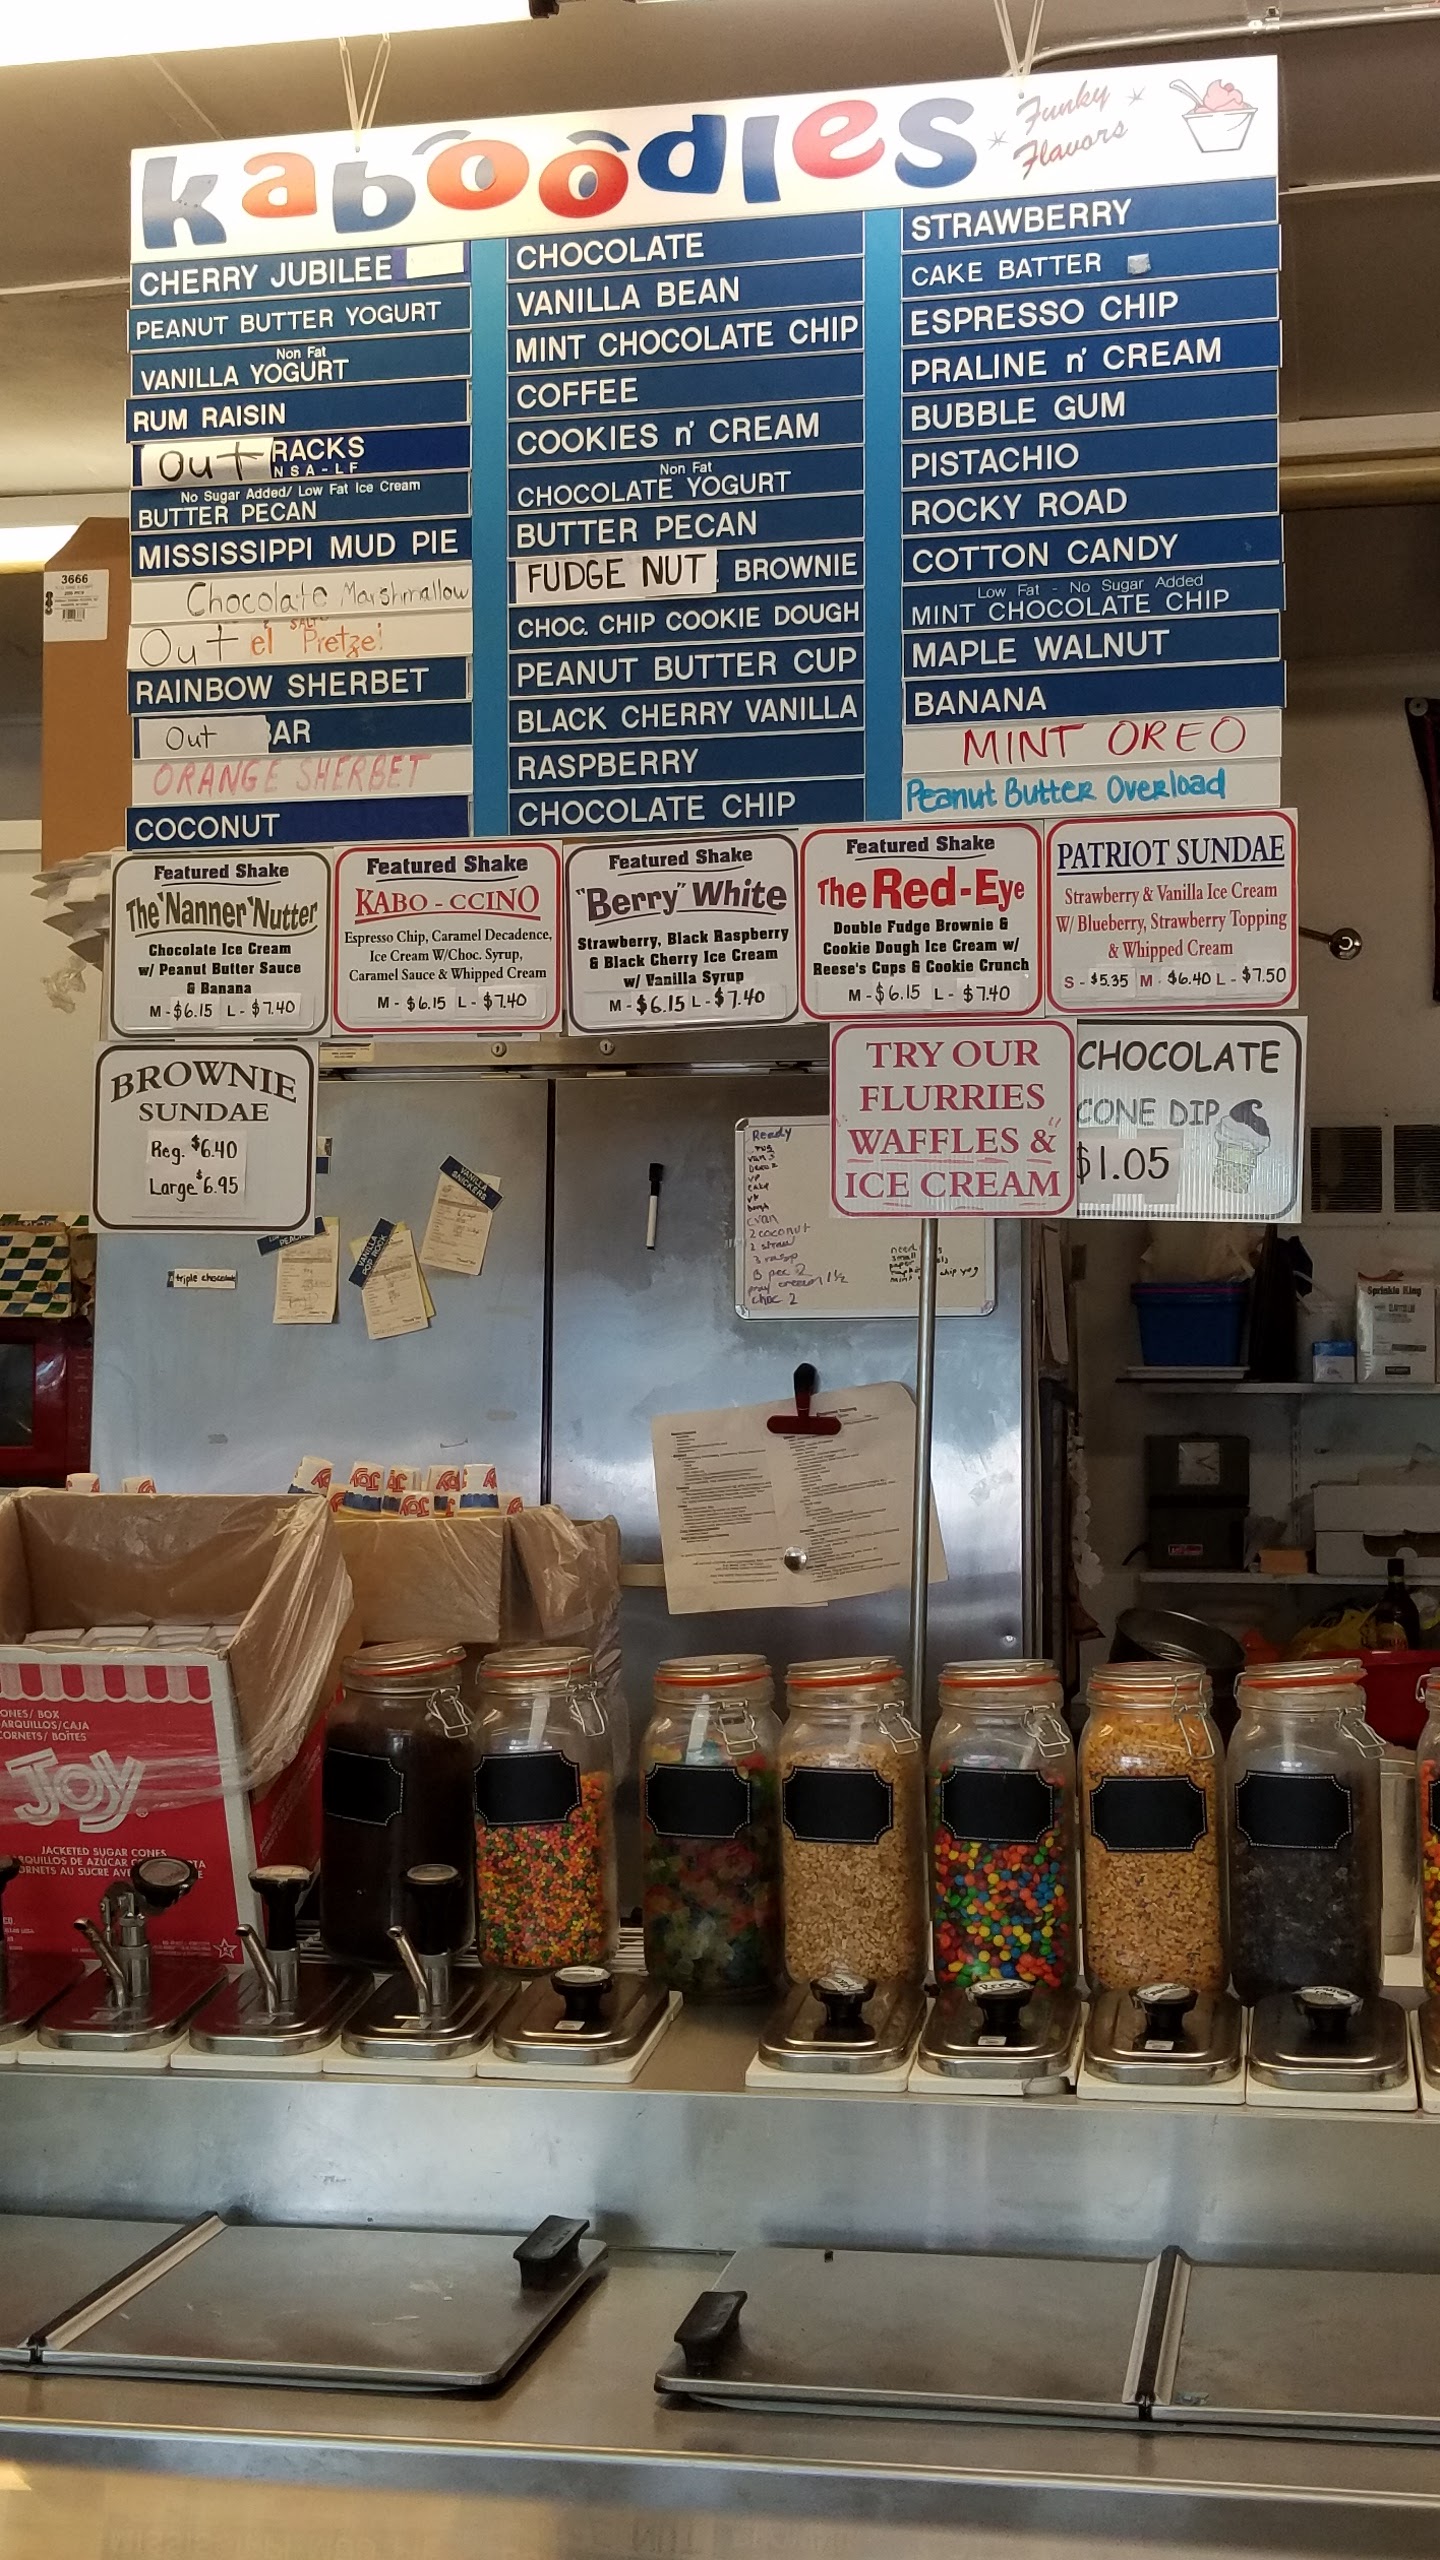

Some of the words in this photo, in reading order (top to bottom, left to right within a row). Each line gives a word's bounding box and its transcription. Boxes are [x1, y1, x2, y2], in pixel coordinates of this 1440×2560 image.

[1016, 80, 1111, 136] Funky
[1013, 120, 1128, 180] Flavors
[142, 97, 977, 249] kaboodles
[911, 198, 1132, 241] STRAWBERRY
[516, 232, 704, 270] CHOCOLATE
[139, 264, 258, 297] CHERRY
[270, 255, 392, 288] JUBILEE
[912, 261, 983, 286] CAKE
[999, 252, 1101, 280] BATTER
[516, 284, 641, 316] VANILLA
[657, 276, 739, 308] BEAN
[136, 316, 229, 340] PEANUT
[240, 310, 334, 334] BUTTER
[346, 301, 441, 326] YOGURT
[911, 299, 1085, 336] ESPRESSO
[1100, 291, 1179, 321] CHIP
[276, 348, 301, 360] Non
[308, 345, 326, 358] Fat
[141, 366, 239, 391] VANILLA
[250, 359, 349, 384] YOGURT
[517, 377, 638, 409] COFFEE
[133, 409, 188, 432] RUM
[202, 403, 286, 428] RAISIN
[911, 397, 1036, 431] BUBBLE
[1054, 391, 1125, 421] GUM
[272, 435, 365, 462] RACKS
[517, 423, 659, 455] COOKIES
[709, 413, 819, 443] CREAM
[159, 442, 264, 481] Out
[911, 443, 1079, 479] PISTACHIO
[181, 492, 198, 503] No
[204, 490, 240, 504] Sugar
[299, 485, 323, 497] Low
[329, 483, 348, 495] Fat
[355, 481, 374, 493] Ice
[380, 480, 421, 492] Cream
[911, 493, 1022, 526] ROCKY
[1038, 488, 1128, 518] ROAD
[138, 537, 313, 570] MISSISSIPPI
[331, 533, 396, 560] MUD
[412, 529, 459, 555] PIE
[912, 542, 1048, 574] COTTON
[1067, 533, 1179, 565] CANDY
[61, 574, 89, 584] 3666
[528, 557, 626, 593] FUDGE
[642, 553, 707, 587] NUT
[735, 552, 857, 582] BROWNIE
[187, 582, 328, 616] Chocolate
[977, 586, 1006, 599] Low
[1017, 584, 1040, 597] Fat
[1070, 581, 1090, 593] No
[1102, 578, 1144, 593] Sugar
[1155, 574, 1203, 589] Added
[912, 638, 1017, 668] MAPLE
[1034, 629, 1170, 661] WALNUT
[136, 675, 273, 705] RAINBOW
[288, 667, 430, 698] SHERBET
[914, 686, 1047, 717] BANANA
[518, 706, 607, 734] BLACK
[621, 700, 732, 729] CHERRY
[746, 694, 858, 723] VANILLA
[963, 723, 1088, 765] MINT
[1108, 716, 1246, 755] OREO
[153, 759, 281, 796] ORANGE
[296, 754, 433, 793] SHERBET
[518, 748, 699, 781] RASPBERRY
[906, 777, 998, 814] Peanut
[1004, 776, 1097, 809] Butter
[1107, 767, 1226, 805] Overload
[134, 813, 281, 841] COCONUT
[1057, 839, 1170, 869] PATRIOT
[1177, 835, 1285, 865] SUNDAE
[154, 865, 230, 880] Featured
[236, 863, 289, 879] Shake
[576, 881, 687, 921] "Berry"
[693, 878, 787, 911] White
[818, 877, 866, 908] The
[873, 866, 1025, 912] Red-Eye
[126, 898, 159, 932] The
[149, 944, 216, 956] Chocolate
[222, 943, 242, 955] Ice
[248, 942, 291, 955] Cream
[345, 931, 394, 947] Espresso
[397, 930, 429, 945] Chip,
[431, 929, 482, 942] Caramel
[485, 928, 552, 942] Decadence,
[578, 936, 662, 950] Strawberry,
[668, 931, 709, 945] Black
[714, 928, 789, 944] Raspberry
[1108, 943, 1119, 958] &
[1123, 939, 1183, 963] Whipped
[1187, 940, 1234, 956] Cream
[813, 962, 866, 975] Reese's
[872, 961, 906, 976] Cups
[926, 960, 974, 972] Cookie
[979, 958, 1029, 971] Crunch
[609, 1000, 622, 1012] M
[636, 995, 685, 1015] $6.15
[692, 996, 701, 1007] L
[714, 987, 765, 1009] $7.40
[866, 1041, 945, 1068] TRY
[952, 1039, 1041, 1067] OUR
[1077, 1040, 1281, 1073] CHOCOLATE
[110, 1060, 297, 1103] BROWNIE
[859, 1083, 1045, 1111] FLURRIES
[139, 1102, 269, 1122] SUNDAE
[1077, 1097, 1156, 1126] CONE
[1169, 1098, 1220, 1126] DIP
[151, 1140, 185, 1165] Reg.
[191, 1135, 238, 1159] $6.40
[752, 1126, 792, 1142] Ready
[847, 1127, 1019, 1155] WAFFLES
[1030, 1129, 1056, 1154] &
[461, 1167, 488, 1192] VANILLA
[1077, 1141, 1170, 1185] $1.05
[149, 1178, 198, 1202] Large
[196, 1169, 239, 1194] $6.95
[452, 1170, 487, 1201] SNICKERS
[844, 1172, 910, 1198] ICE
[920, 1170, 1061, 1198] CREAM
[759, 1223, 811, 1238] coconut
[358, 1235, 378, 1267] VANILLA
[362, 1257, 373, 1276] POP
[372, 1234, 388, 1257] ROCK
[176, 1274, 197, 1286] triple
[0, 1709, 33, 1719] ONES/
[37, 1710, 60, 1719] BOX
[42, 1846, 89, 1856] JACKETED
[93, 1847, 128, 1857] SUGAR
